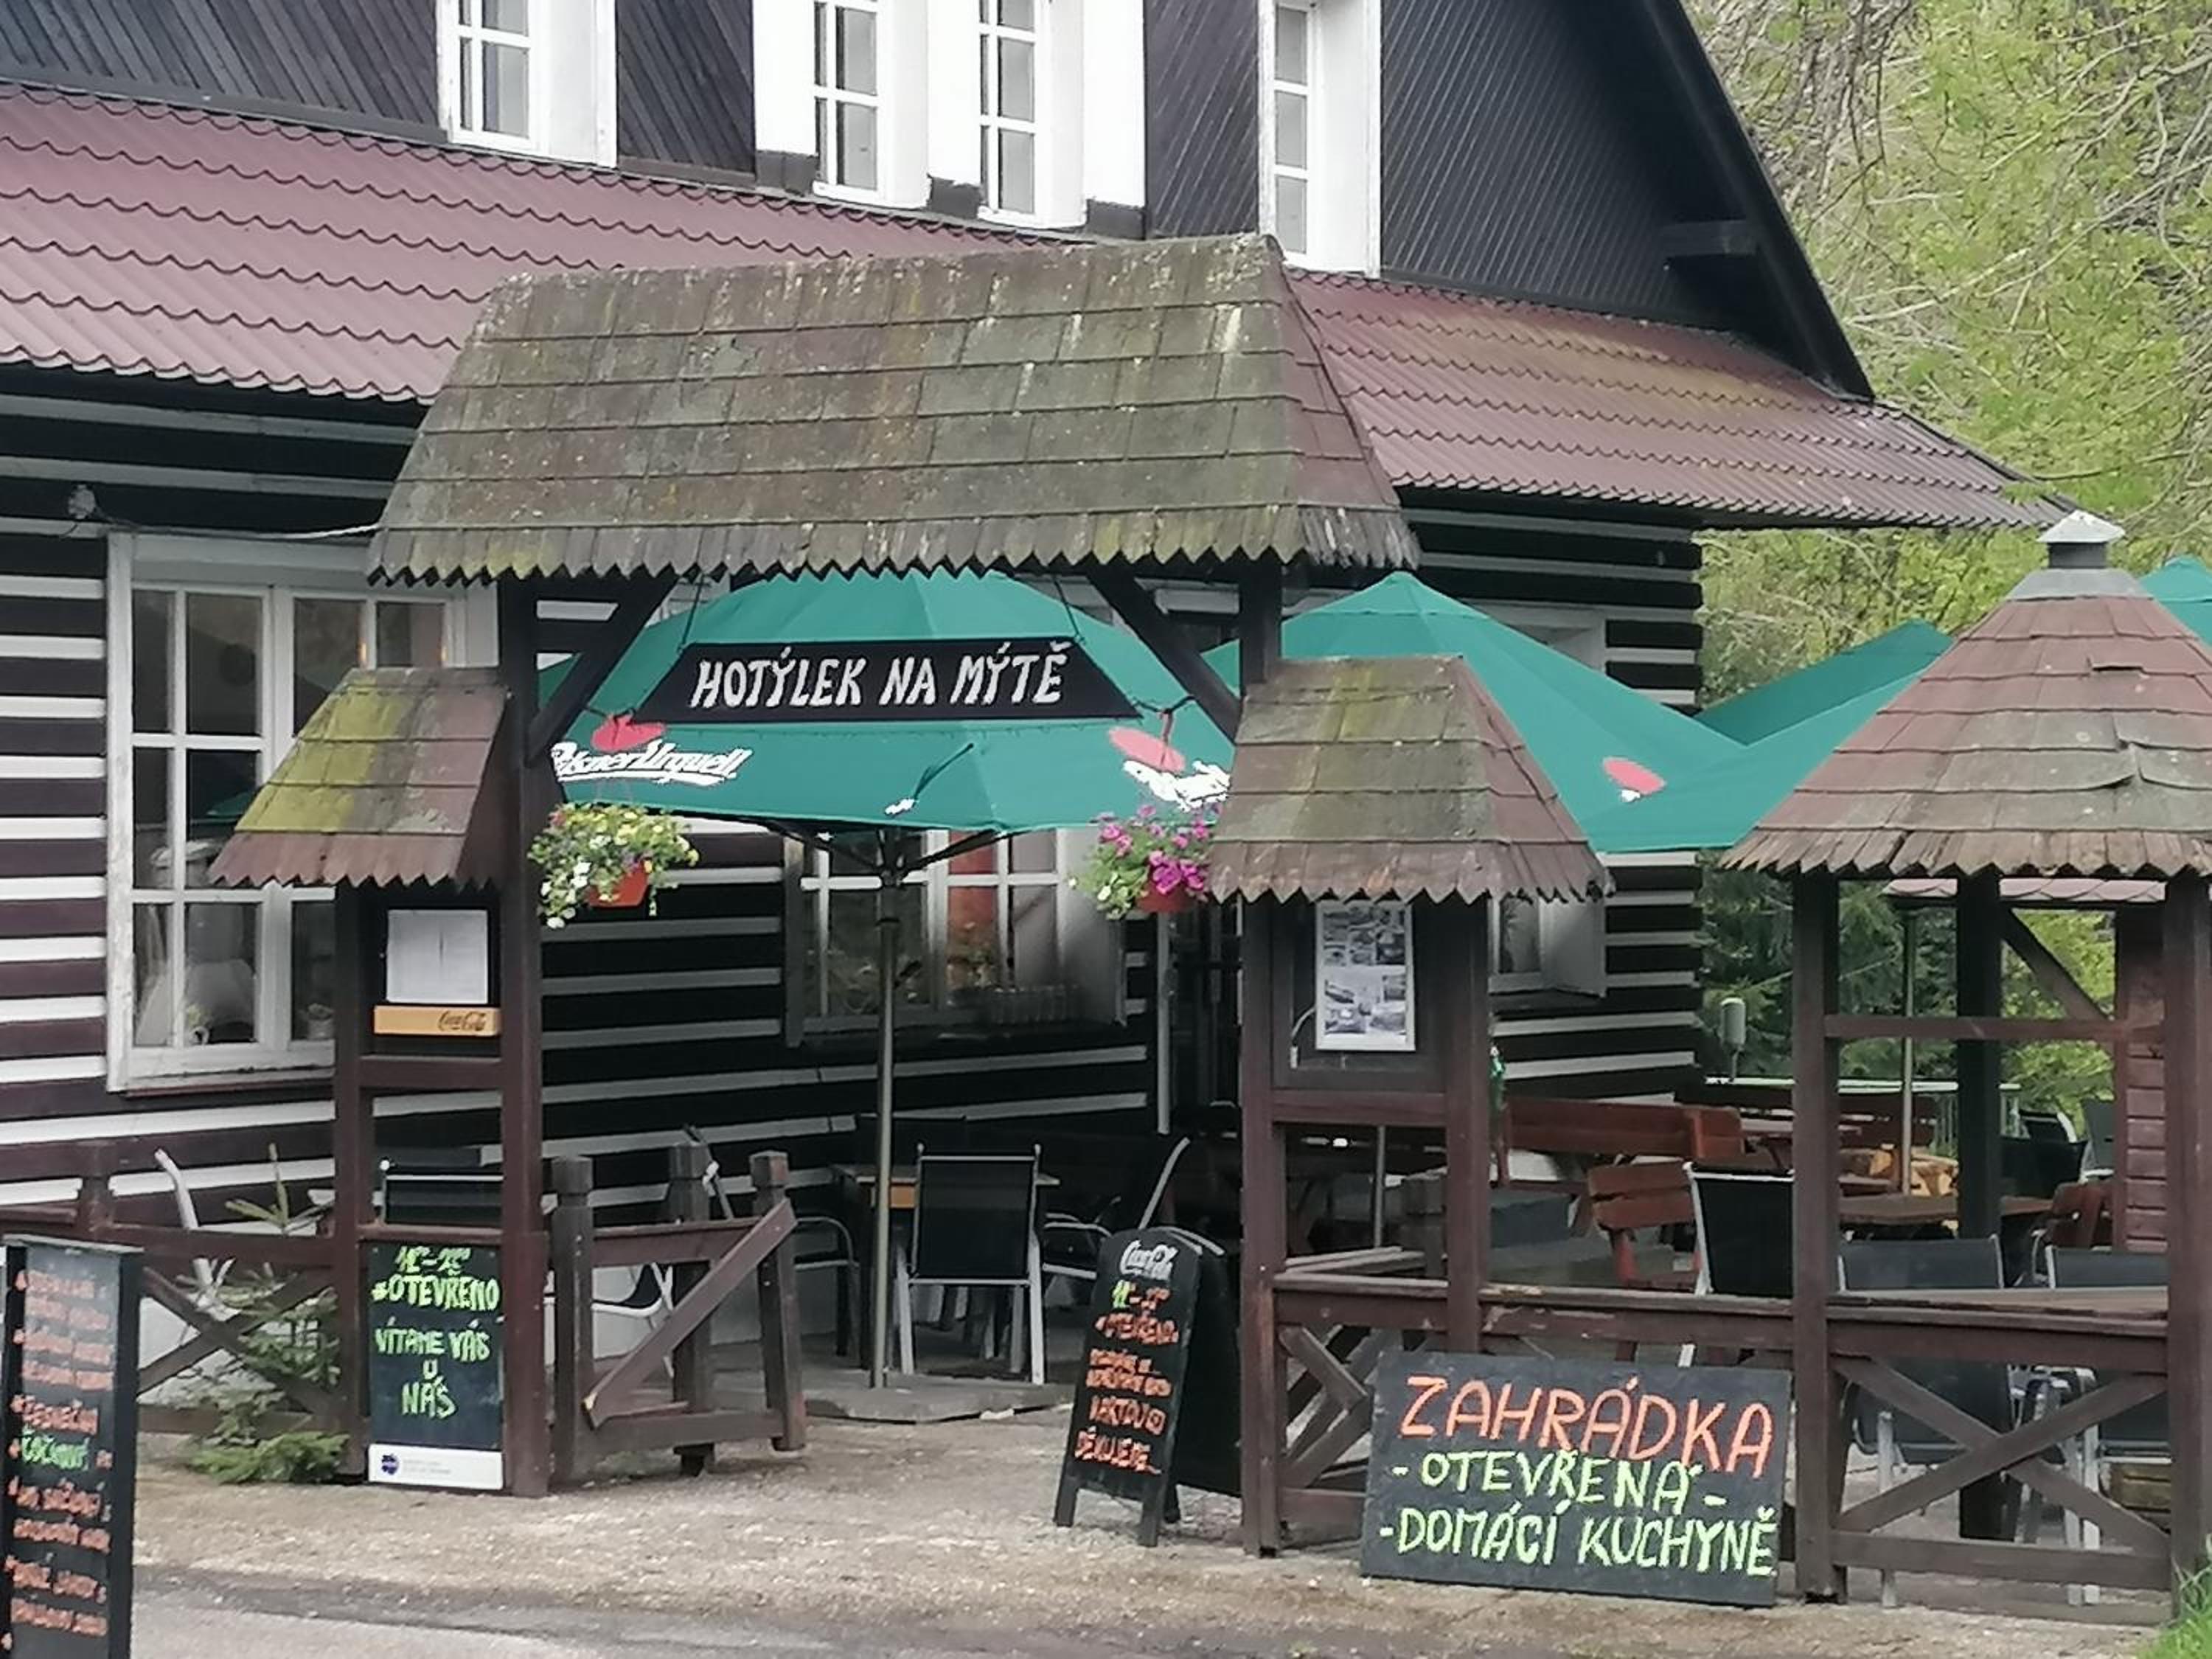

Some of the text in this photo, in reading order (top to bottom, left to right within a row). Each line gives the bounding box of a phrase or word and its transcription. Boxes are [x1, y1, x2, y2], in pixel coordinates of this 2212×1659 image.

[689, 641, 1074, 709] HOTÝLEK NA MÝTĚ
[448, 1318, 491, 1363] VÁS
[401, 1375, 458, 1419] NÁS
[1399, 1374, 1774, 1479] ZAHRÁDKA
[1420, 1449, 1703, 1516] OTEVŘENÁ
[1577, 1505, 1778, 1578] KUCHYNĚ
